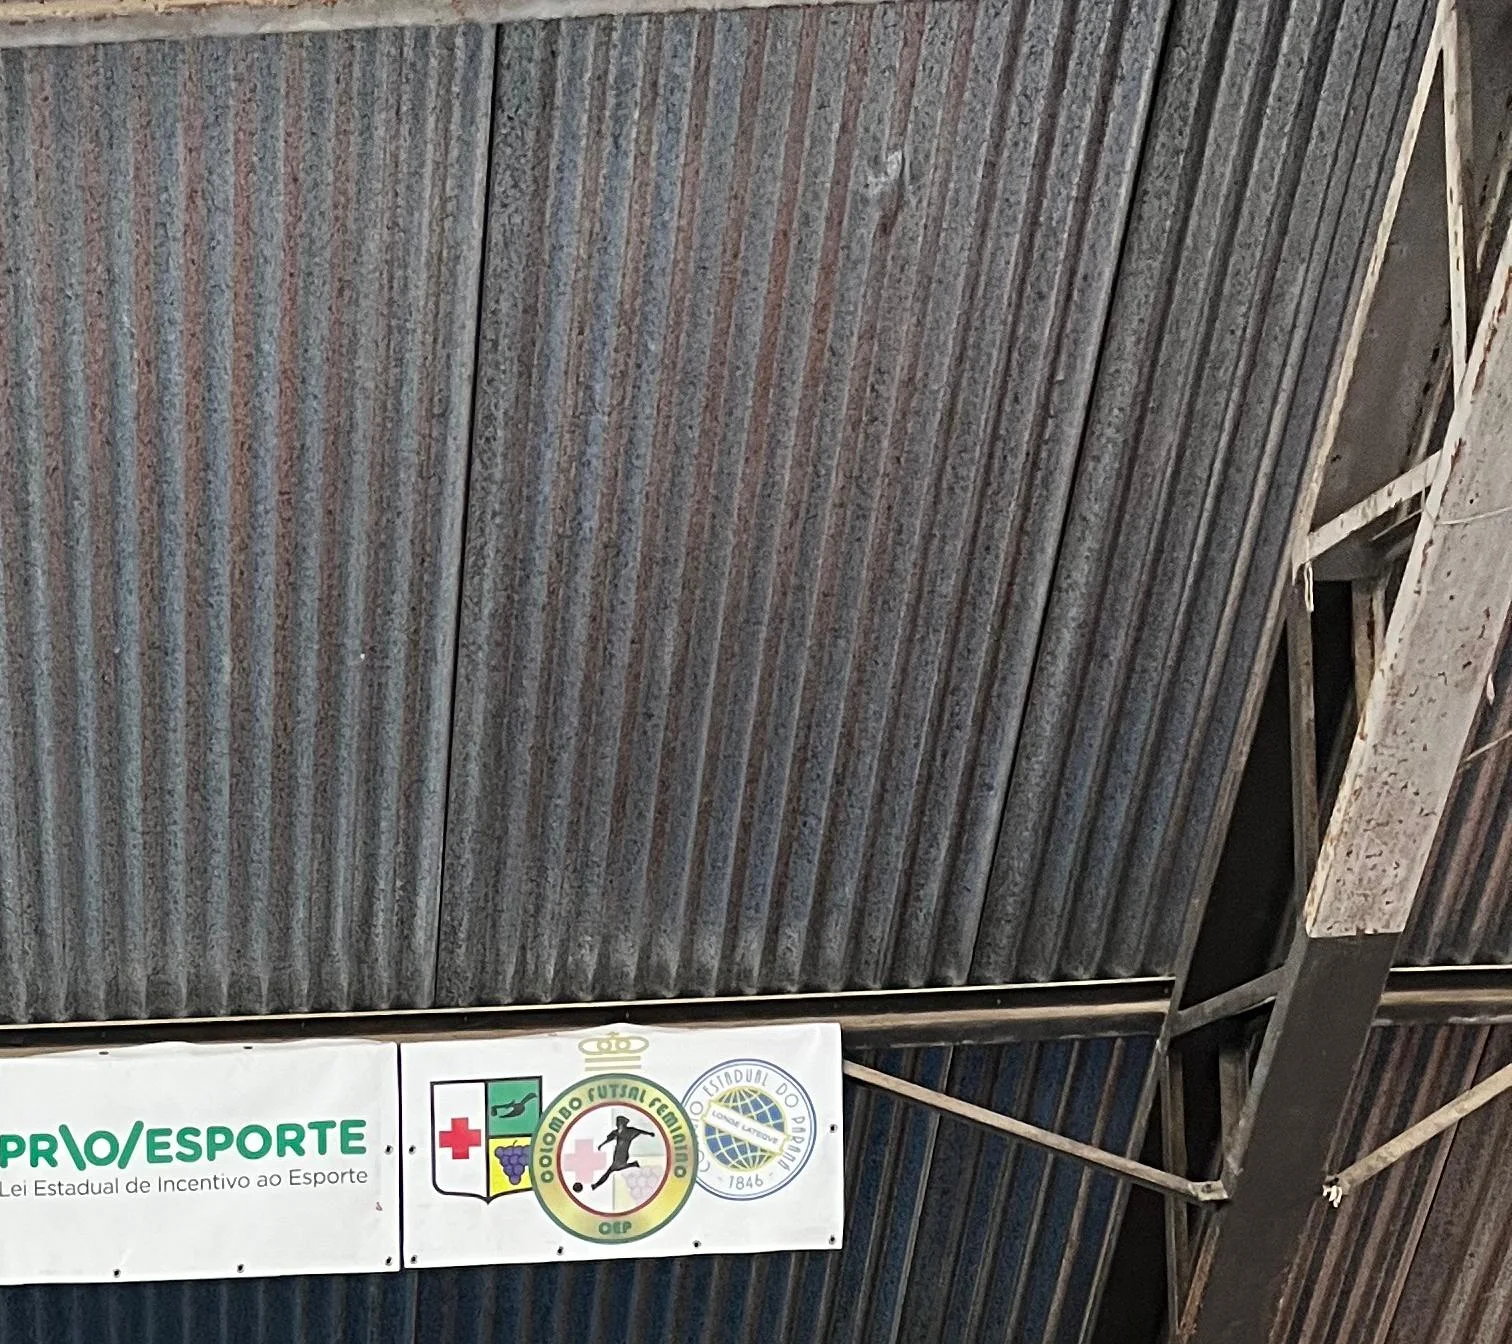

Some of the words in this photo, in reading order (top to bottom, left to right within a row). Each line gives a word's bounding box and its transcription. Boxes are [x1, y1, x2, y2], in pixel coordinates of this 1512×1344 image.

[702, 1069, 769, 1097] ESTADUAL
[775, 1083, 799, 1108] DO
[539, 1097, 583, 1183] COLOMBO
[587, 1083, 647, 1102] FUTSAL
[648, 1097, 689, 1178] FEMININO
[0, 1180, 27, 1198] Lei
[34, 1178, 119, 1197] Estadual
[125, 1176, 151, 1194] de
[158, 1173, 250, 1193] Incentivo
[256, 1174, 282, 1188] ao
[289, 1168, 368, 1188] Esporte
[729, 1173, 764, 1191] 1846
[598, 1221, 632, 1235] CEP
